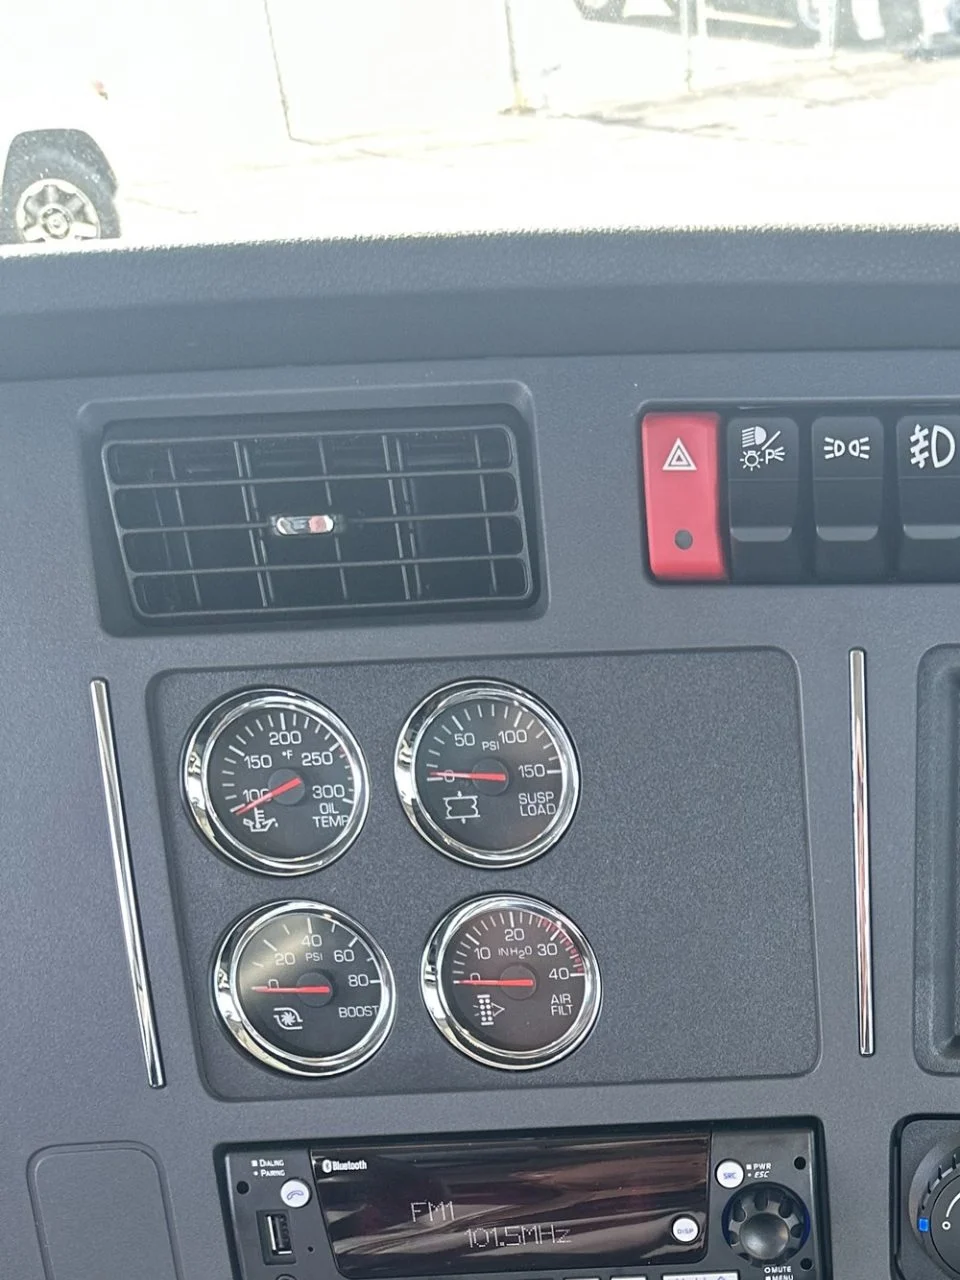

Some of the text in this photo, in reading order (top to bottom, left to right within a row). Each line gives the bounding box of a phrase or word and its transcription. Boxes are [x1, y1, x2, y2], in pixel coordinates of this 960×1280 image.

[269, 731, 302, 746] 200
[454, 733, 476, 747] 50
[499, 729, 528, 744] 100
[482, 741, 500, 751] PSI
[244, 755, 272, 768] 150
[301, 751, 333, 766] 250
[443, 769, 455, 783] 0
[518, 764, 545, 778] 150
[312, 784, 345, 799] 300
[518, 791, 555, 804] SUSP
[319, 802, 339, 815] OIL
[519, 803, 556, 817] LOAD
[312, 815, 349, 828] TEMP
[301, 934, 322, 948] 40
[504, 928, 525, 942] 20
[305, 952, 323, 962] PSI
[333, 949, 355, 963] 60
[474, 946, 491, 960] 10
[537, 943, 558, 957] 30
[274, 952, 296, 966] 20
[348, 974, 369, 987] 80
[548, 967, 570, 980] 40
[550, 993, 571, 1005] AIR
[338, 1005, 379, 1018] BOOST
[551, 1004, 573, 1016] FILT
[332, 1160, 368, 1171] Bluetooth
[752, 1162, 772, 1170] PWR
[410, 1200, 455, 1223] FM1
[464, 1223, 573, 1248] 101.5MHz
